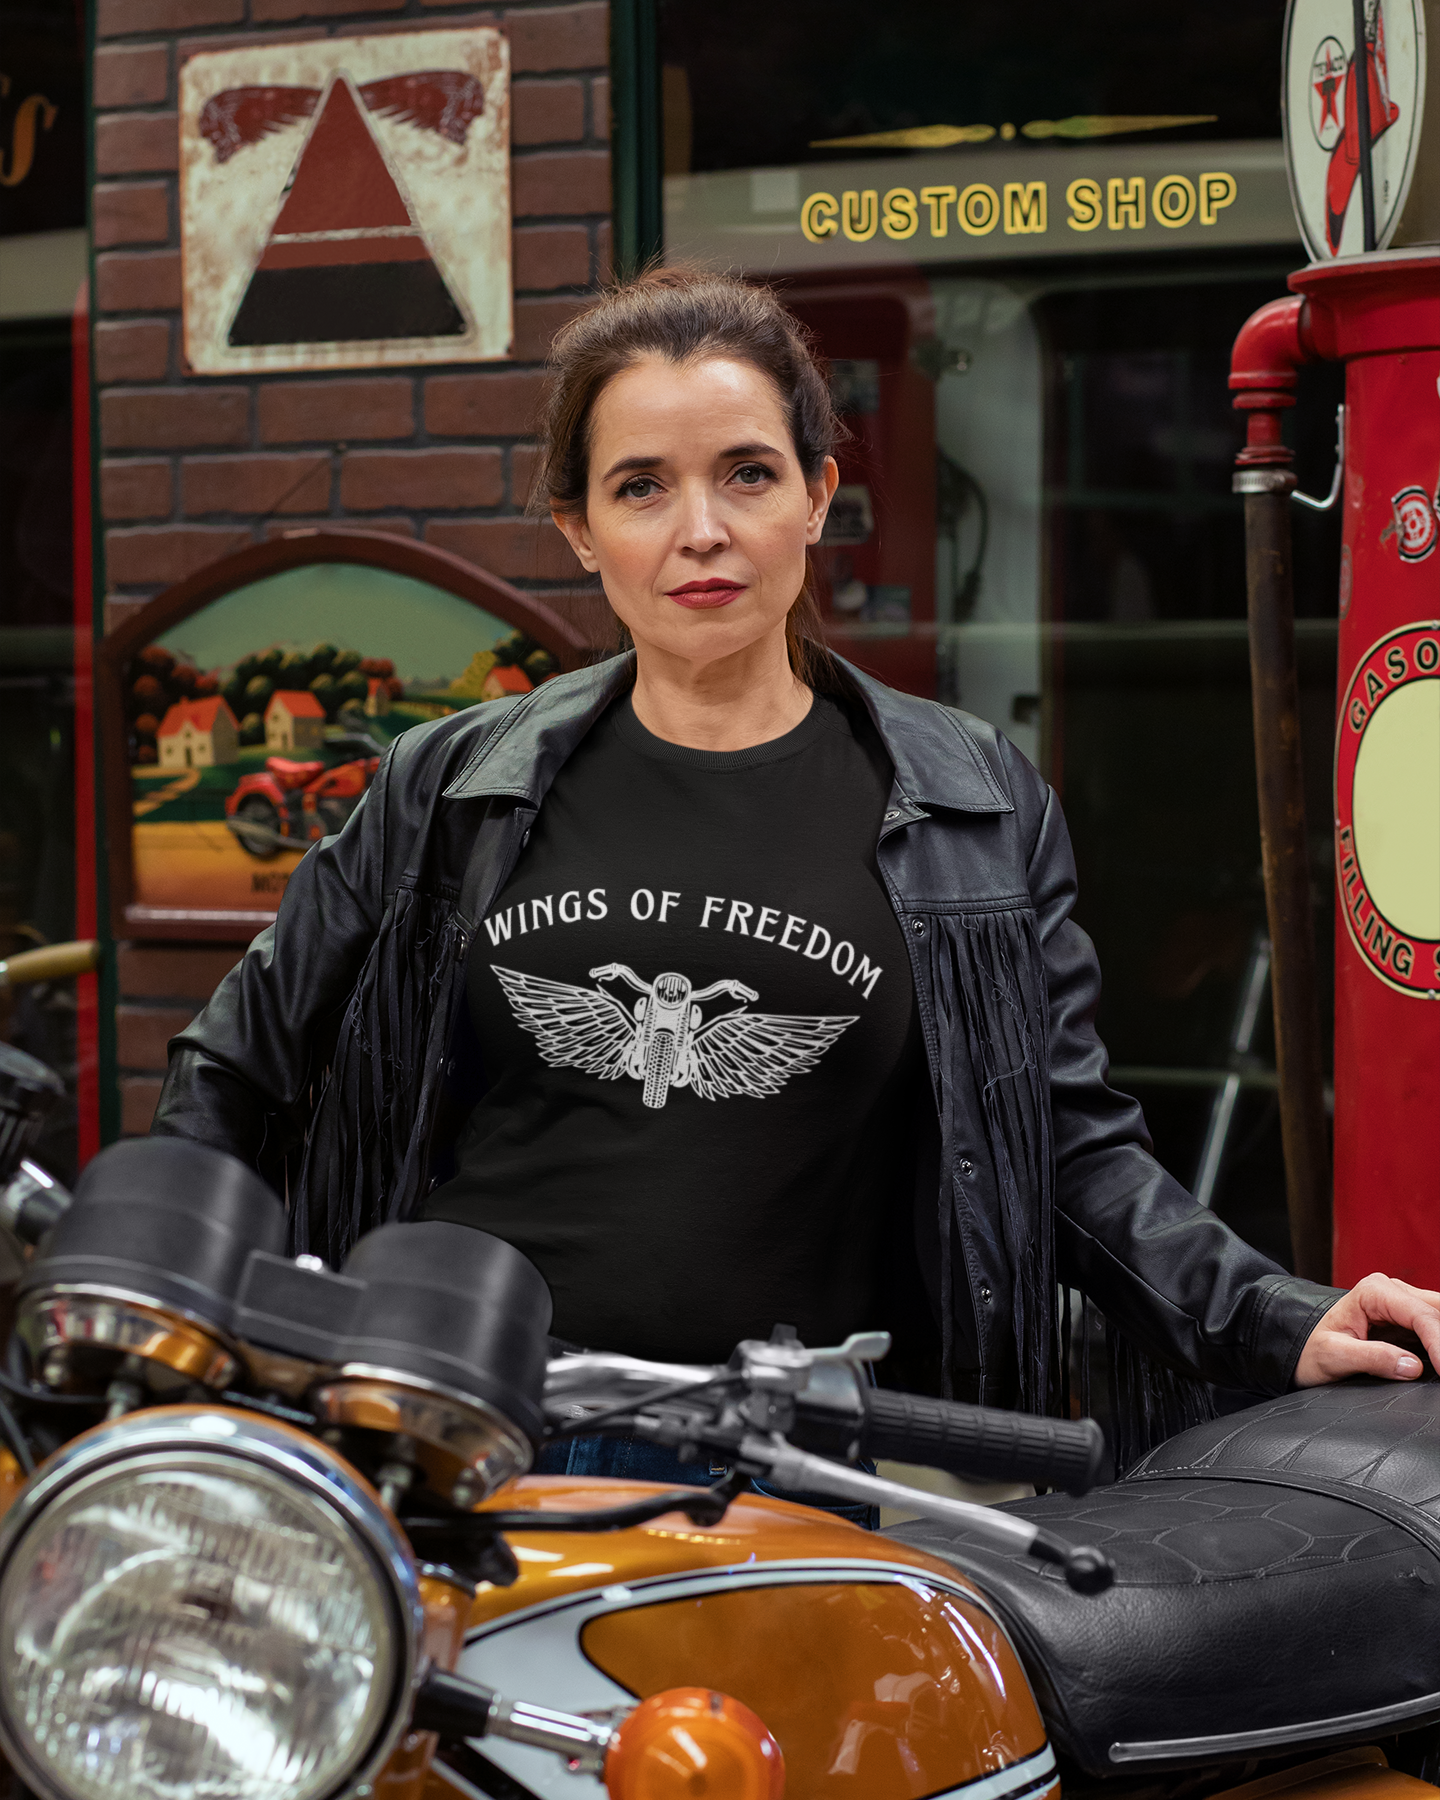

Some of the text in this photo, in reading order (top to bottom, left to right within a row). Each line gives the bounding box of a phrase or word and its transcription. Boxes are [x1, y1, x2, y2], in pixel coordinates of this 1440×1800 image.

[800, 172, 1237, 243] CUSTOM SHOP
[483, 887, 884, 1000] WINGS OF FREEDOM
[1340, 825, 1416, 980] FILLING
